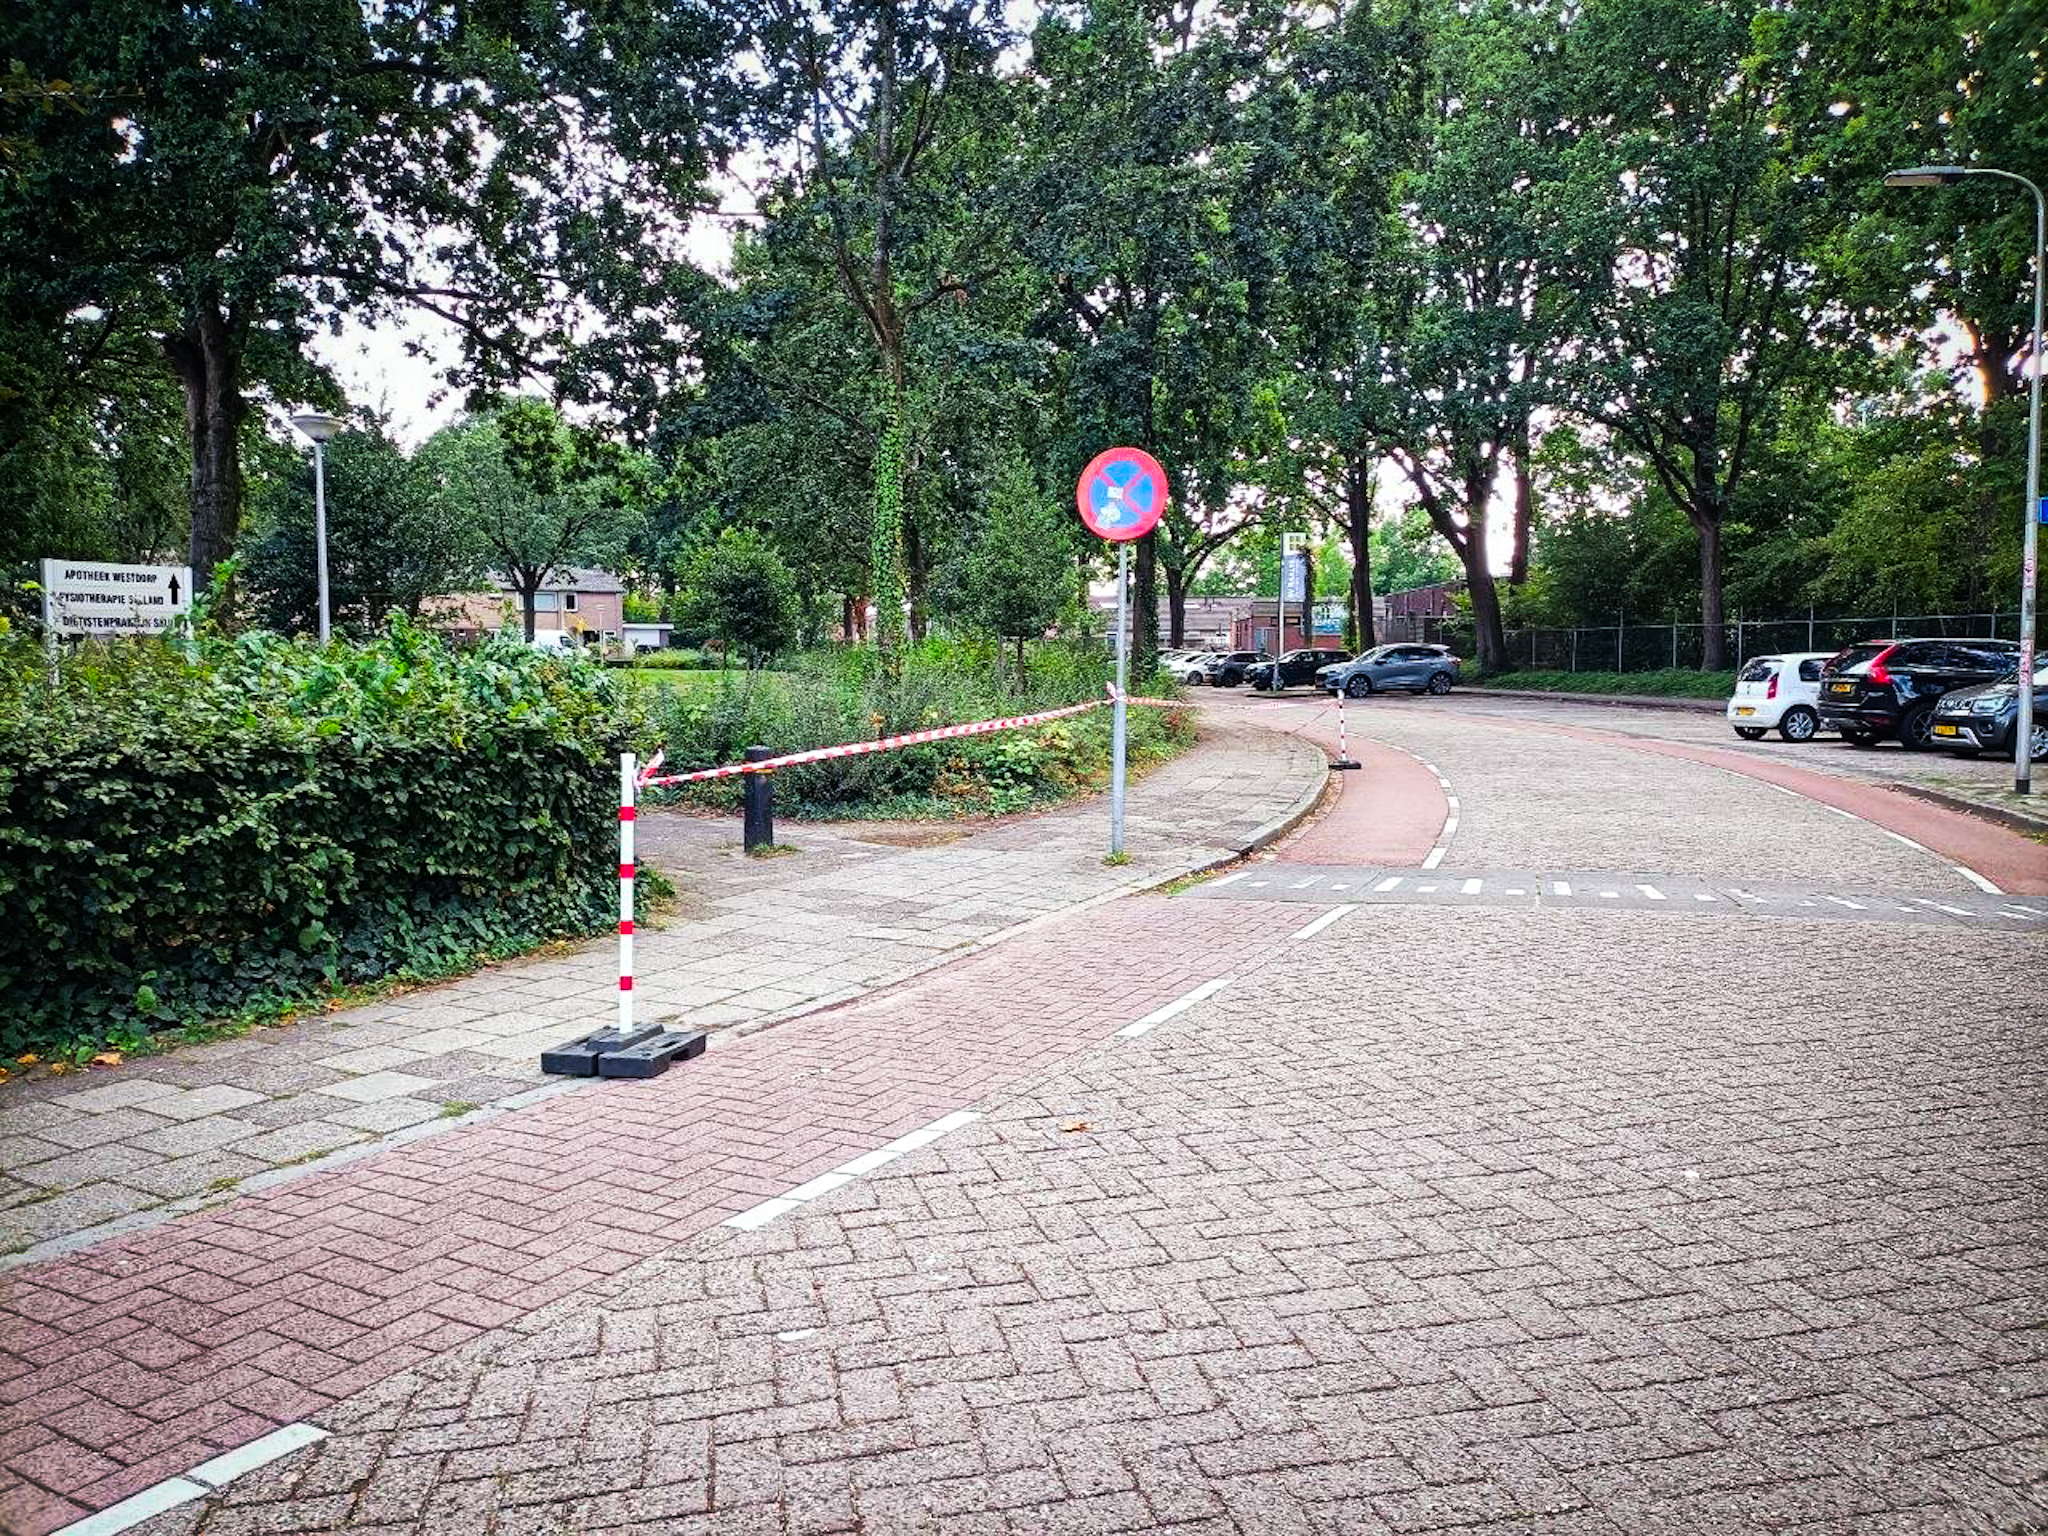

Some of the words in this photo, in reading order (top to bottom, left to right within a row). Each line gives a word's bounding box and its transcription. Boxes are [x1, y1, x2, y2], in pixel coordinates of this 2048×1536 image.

[64, 569, 110, 582] APOTHEEK
[112, 572, 158, 583] WESTDORP
[128, 595, 164, 605] SLAND
